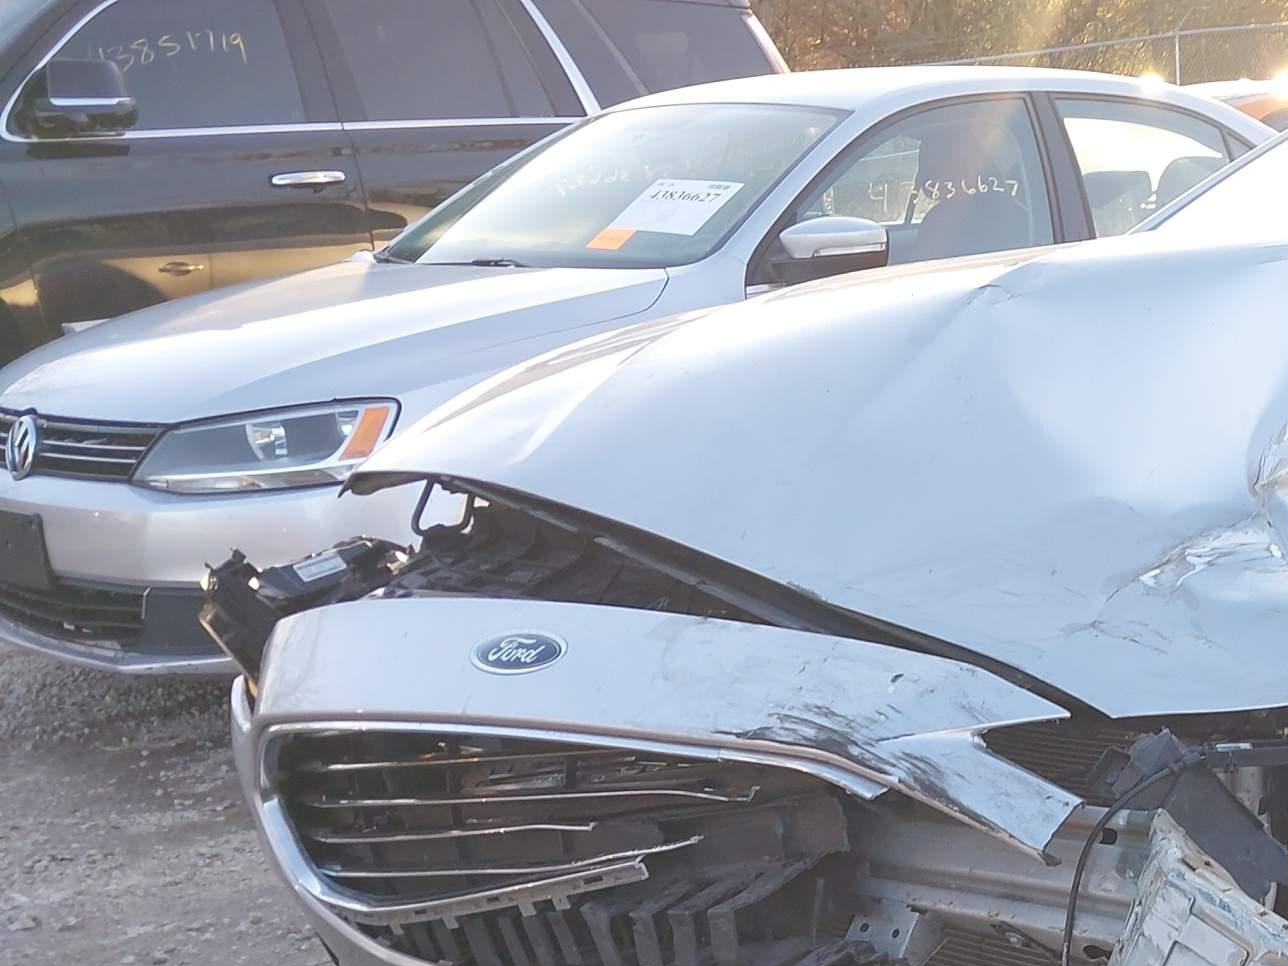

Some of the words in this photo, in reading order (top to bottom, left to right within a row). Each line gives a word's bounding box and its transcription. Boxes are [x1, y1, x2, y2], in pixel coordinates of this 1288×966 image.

[650, 190, 721, 203] 43836627
[867, 175, 1018, 213] 43836627
[488, 636, 546, 663] Ford
